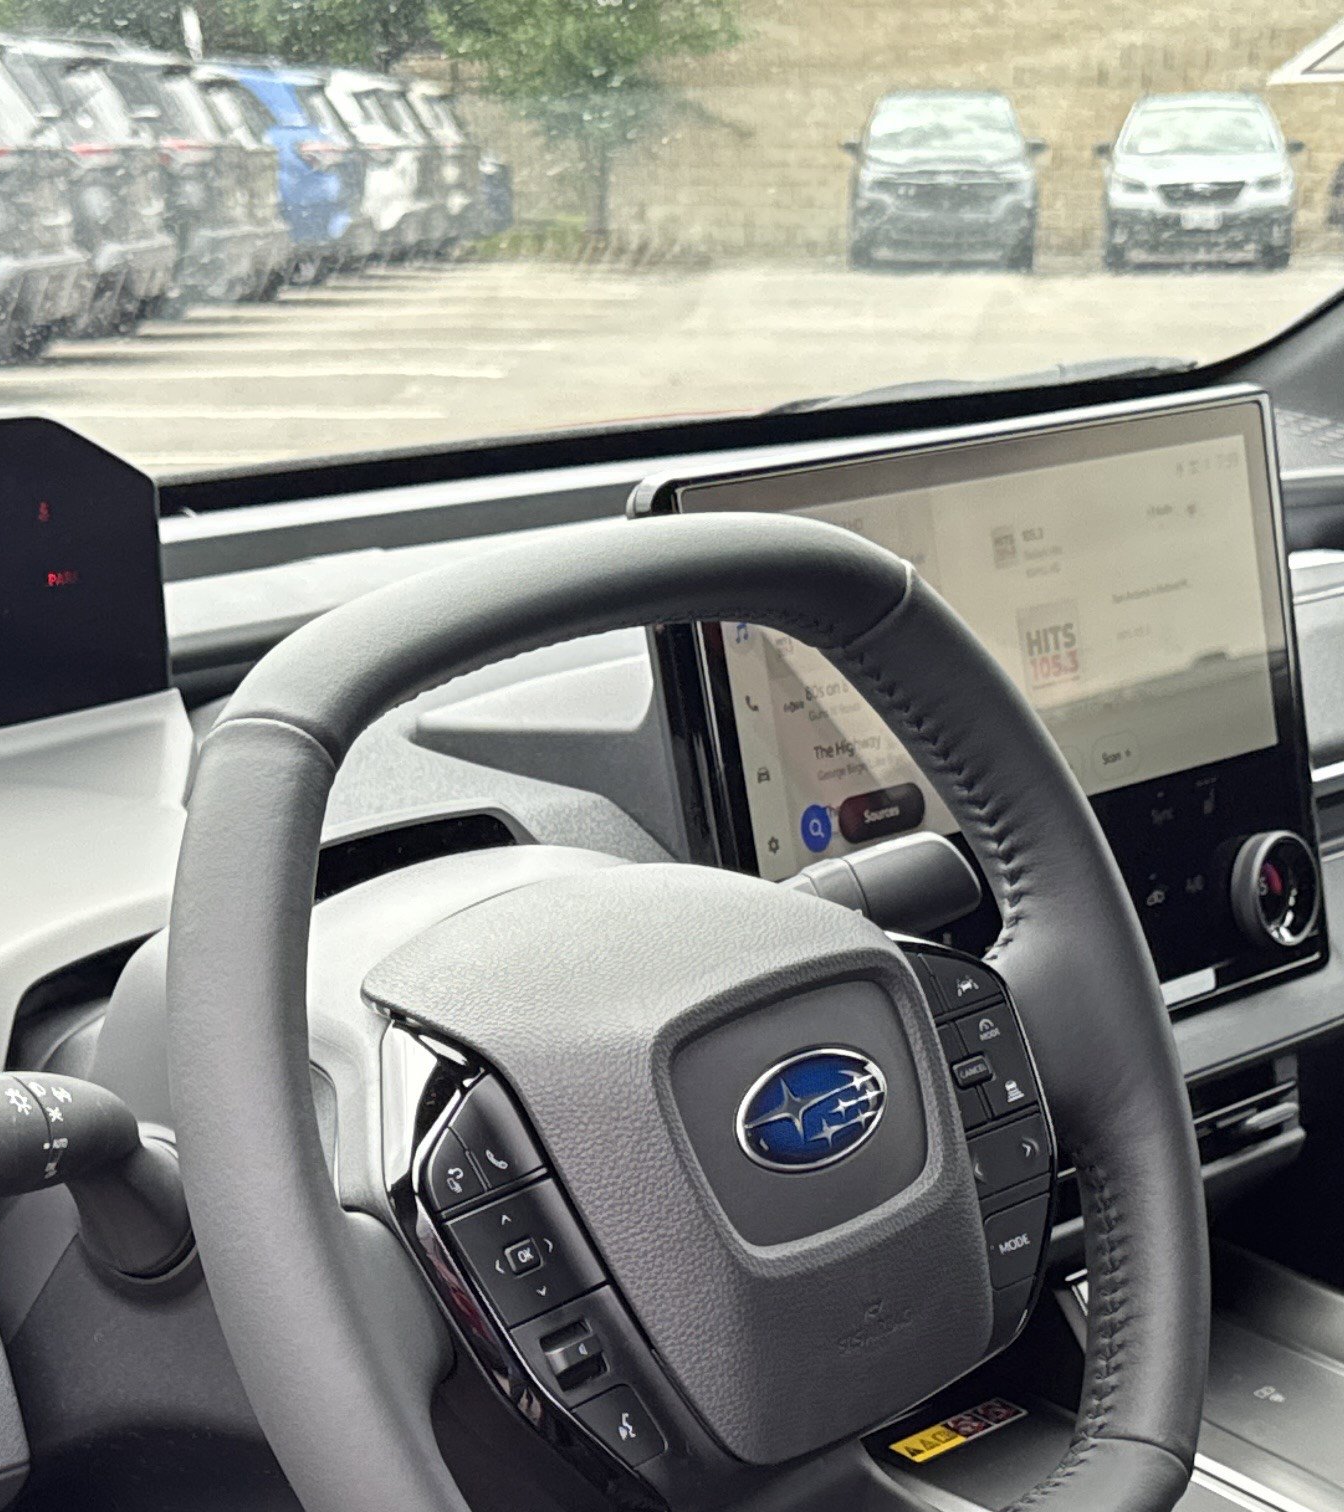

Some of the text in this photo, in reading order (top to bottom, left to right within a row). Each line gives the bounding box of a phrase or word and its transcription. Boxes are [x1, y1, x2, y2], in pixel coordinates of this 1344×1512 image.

[1026, 623, 1076, 656] HITS
[1030, 650, 1080, 681] 105.3
[814, 744, 835, 760] The
[517, 1247, 534, 1263] OK
[998, 1233, 1031, 1255] MODE
